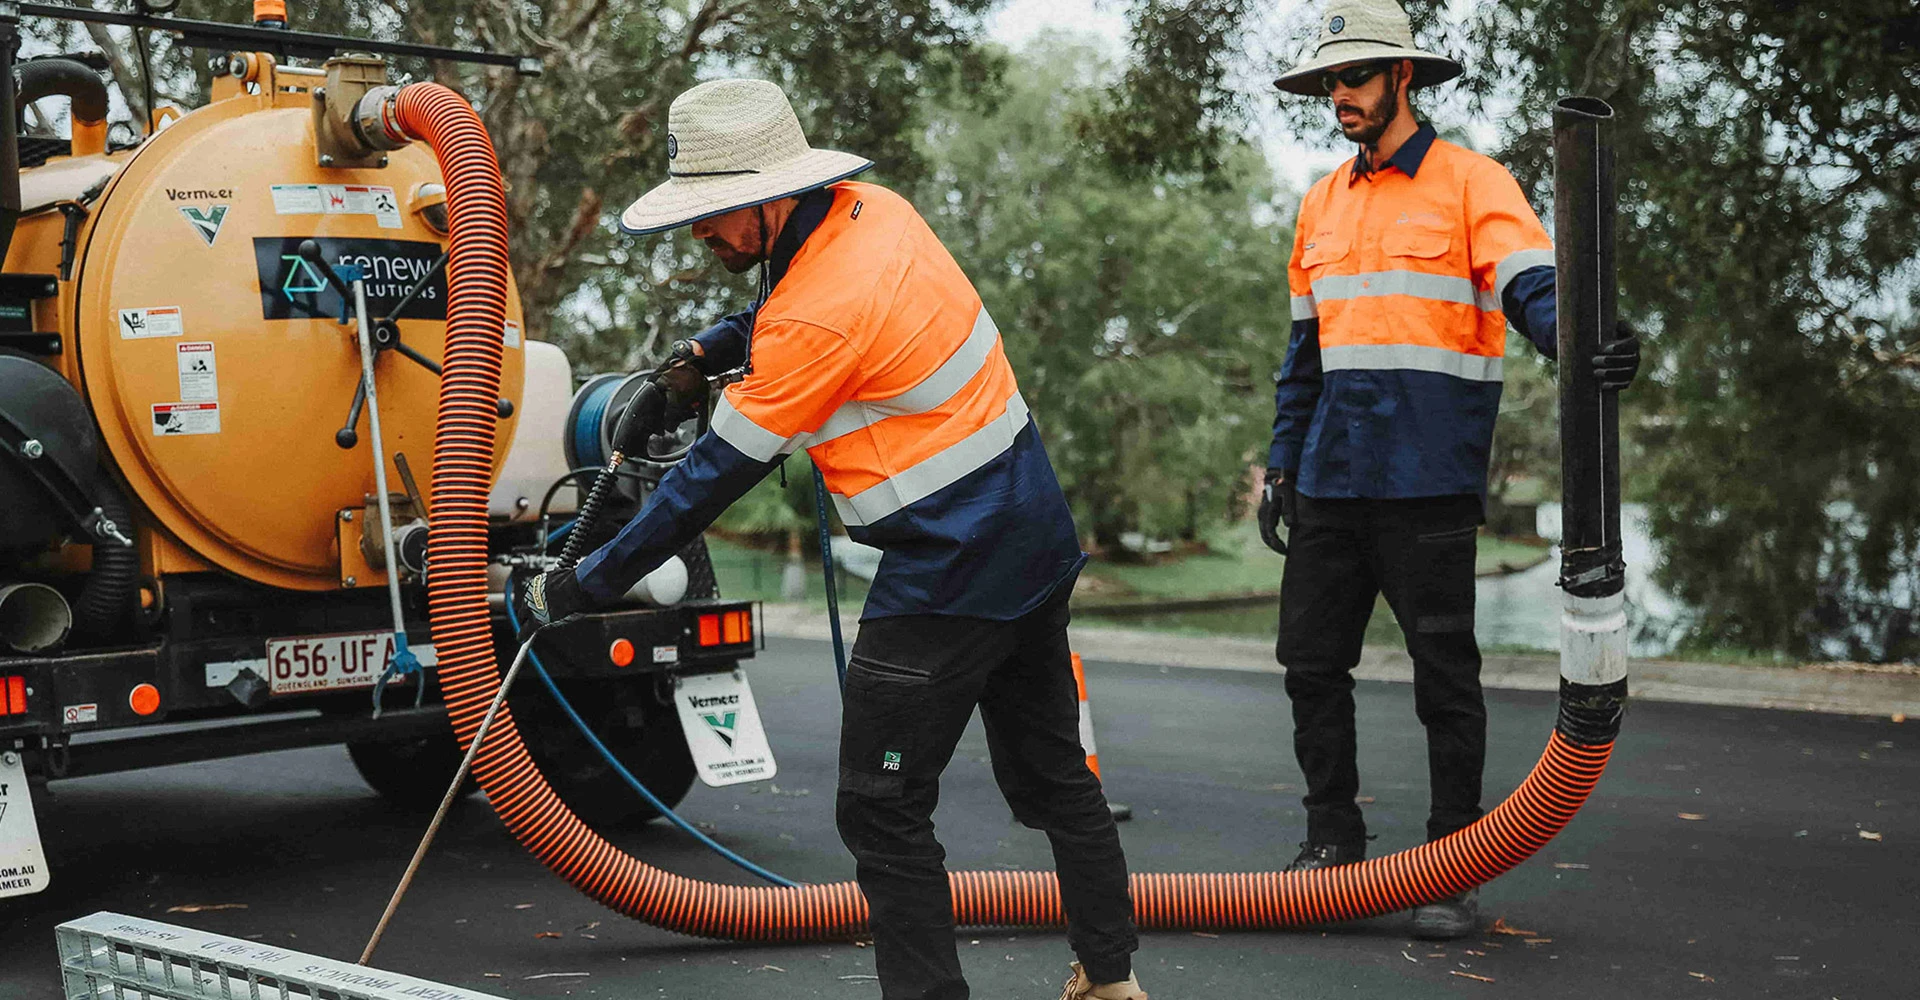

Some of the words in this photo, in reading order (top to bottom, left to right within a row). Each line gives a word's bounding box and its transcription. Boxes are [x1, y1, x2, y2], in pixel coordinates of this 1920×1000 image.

[165, 188, 233, 201] Vermeer
[338, 254, 432, 281] renew
[882, 761, 900, 771] FXD
[0, 865, 35, 878] OM.AU
[0, 878, 31, 890] MEER
[298, 965, 399, 990] PRODUCTS
